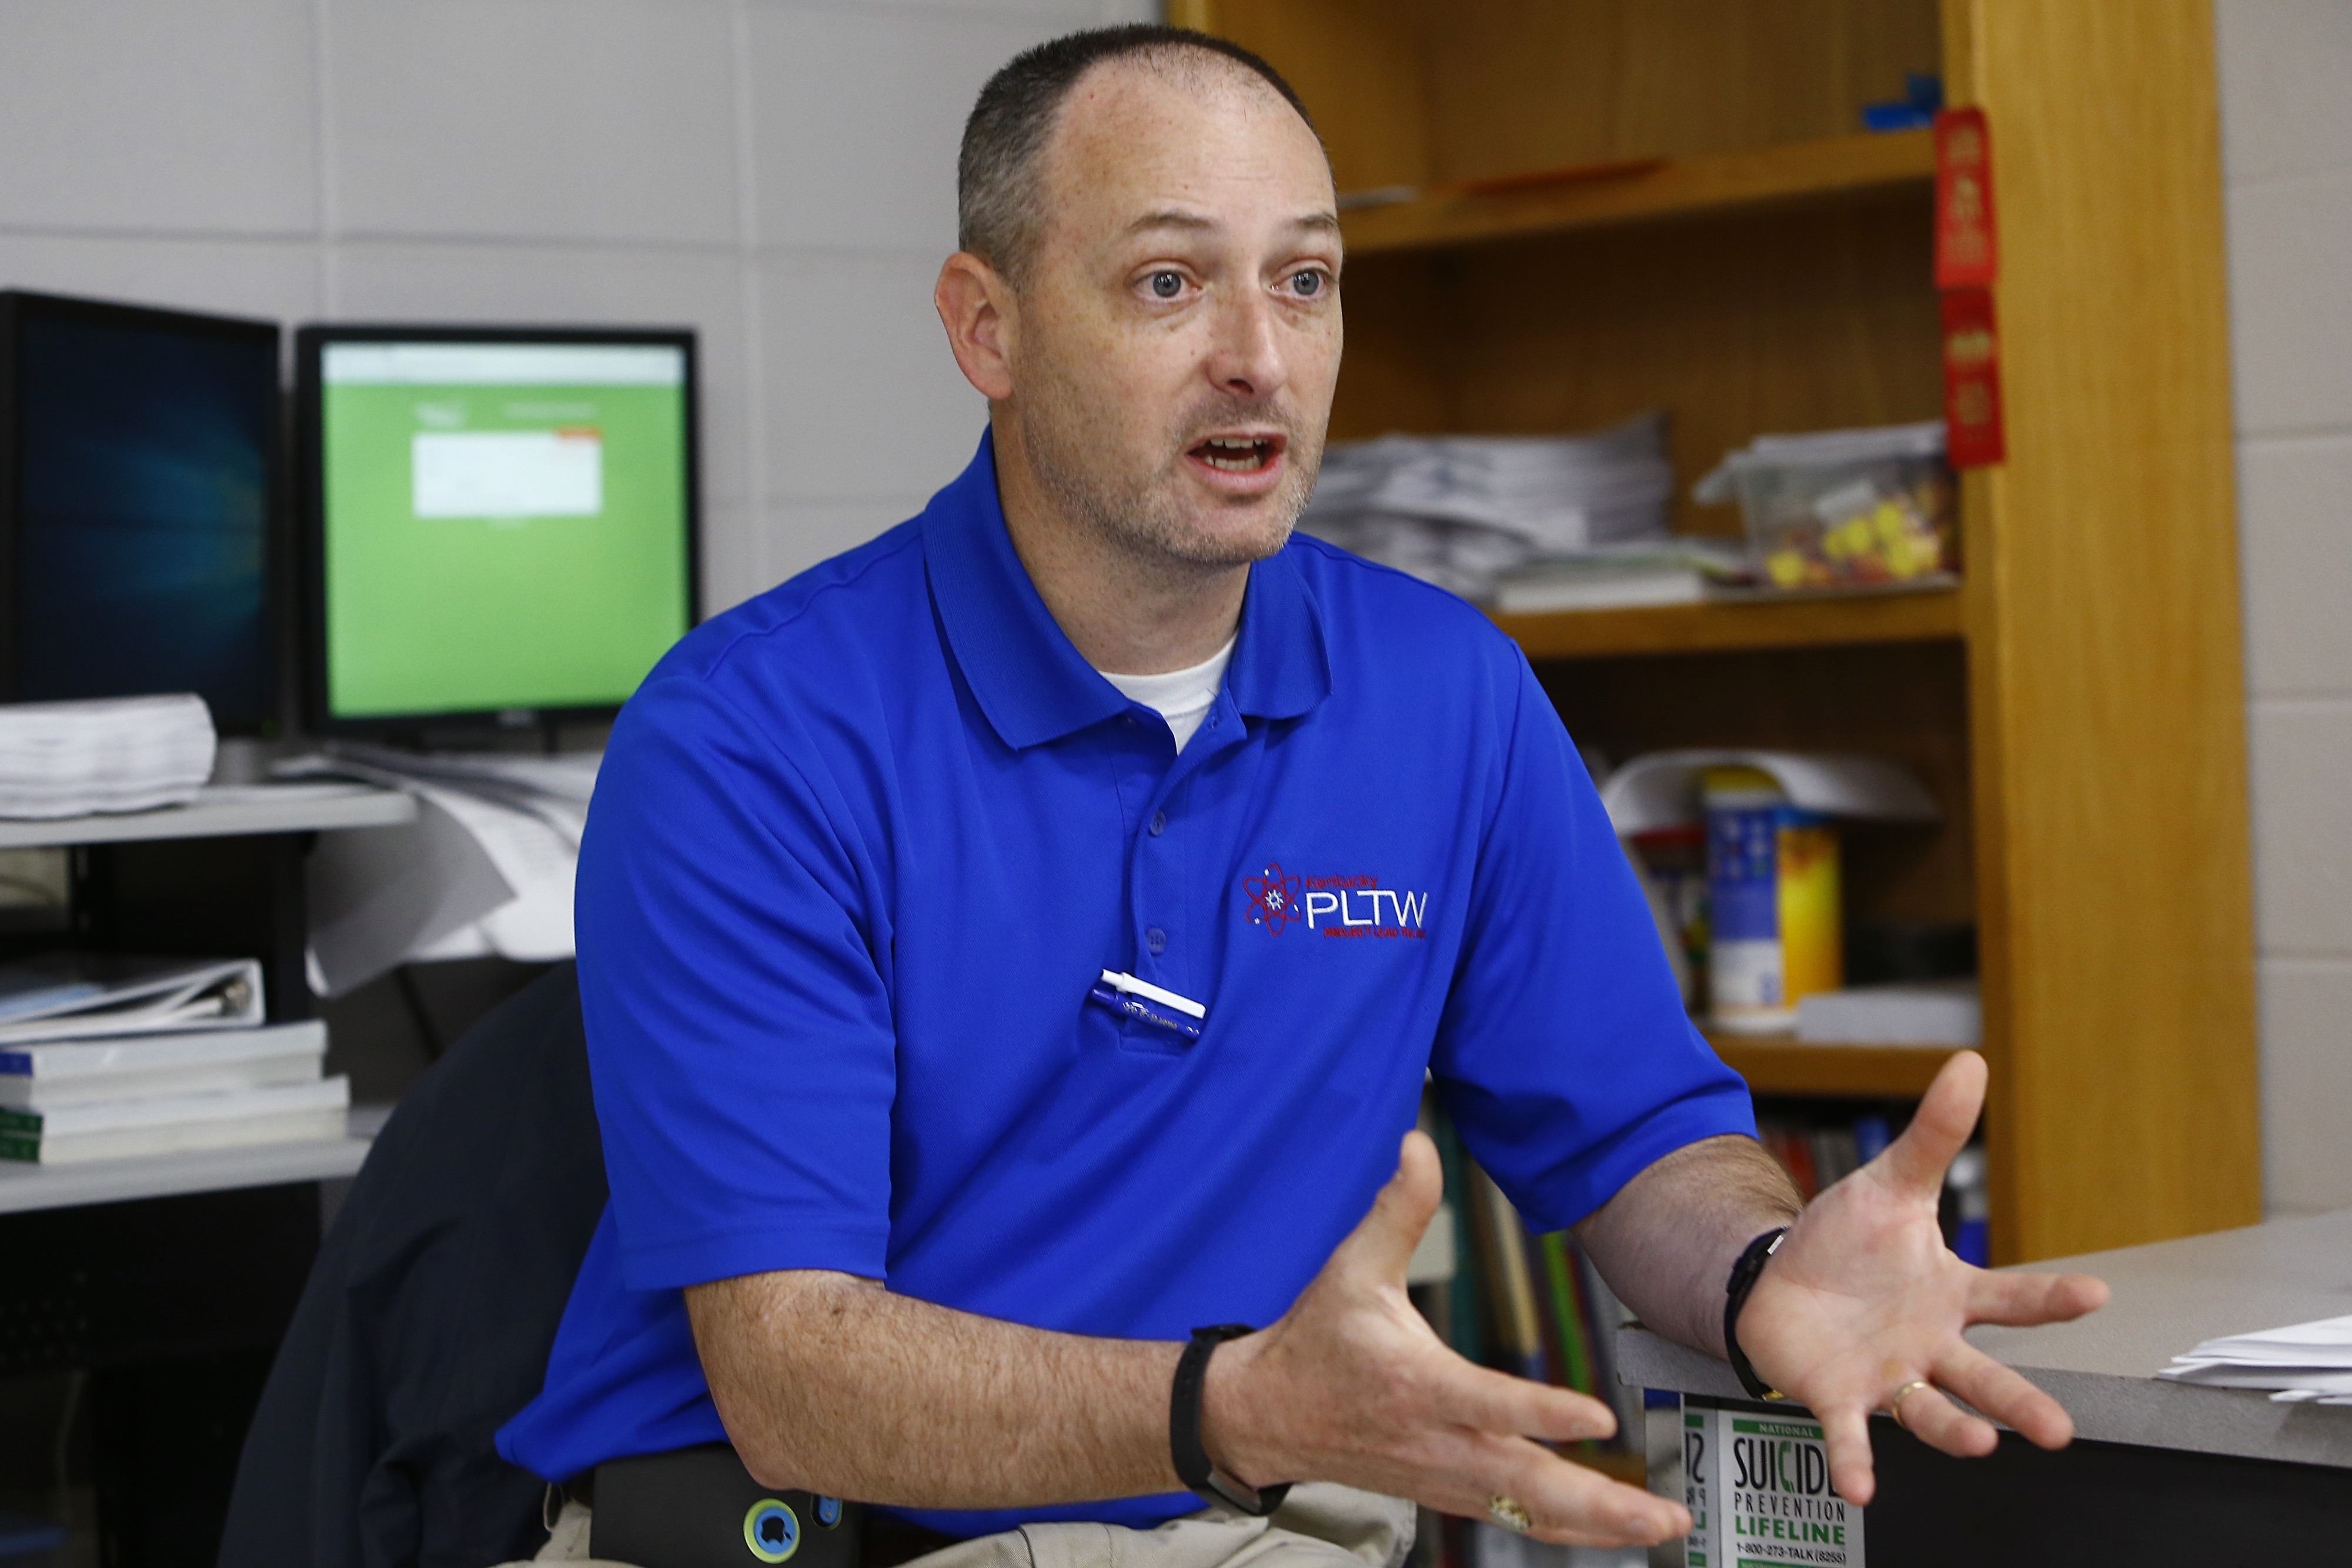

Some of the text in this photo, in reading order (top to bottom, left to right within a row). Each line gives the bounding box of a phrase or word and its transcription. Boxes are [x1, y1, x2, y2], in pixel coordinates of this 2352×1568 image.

[1305, 874, 1377, 890] Kentucky
[1306, 890, 1428, 929] PLTW
[1324, 927, 1370, 939] PROJECT
[1372, 927, 1398, 938] LEAD
[1759, 1423, 1813, 1437] NATIONAL
[1735, 1492, 1845, 1523] PREVENTION
[1735, 1515, 1845, 1545] LIFELINE
